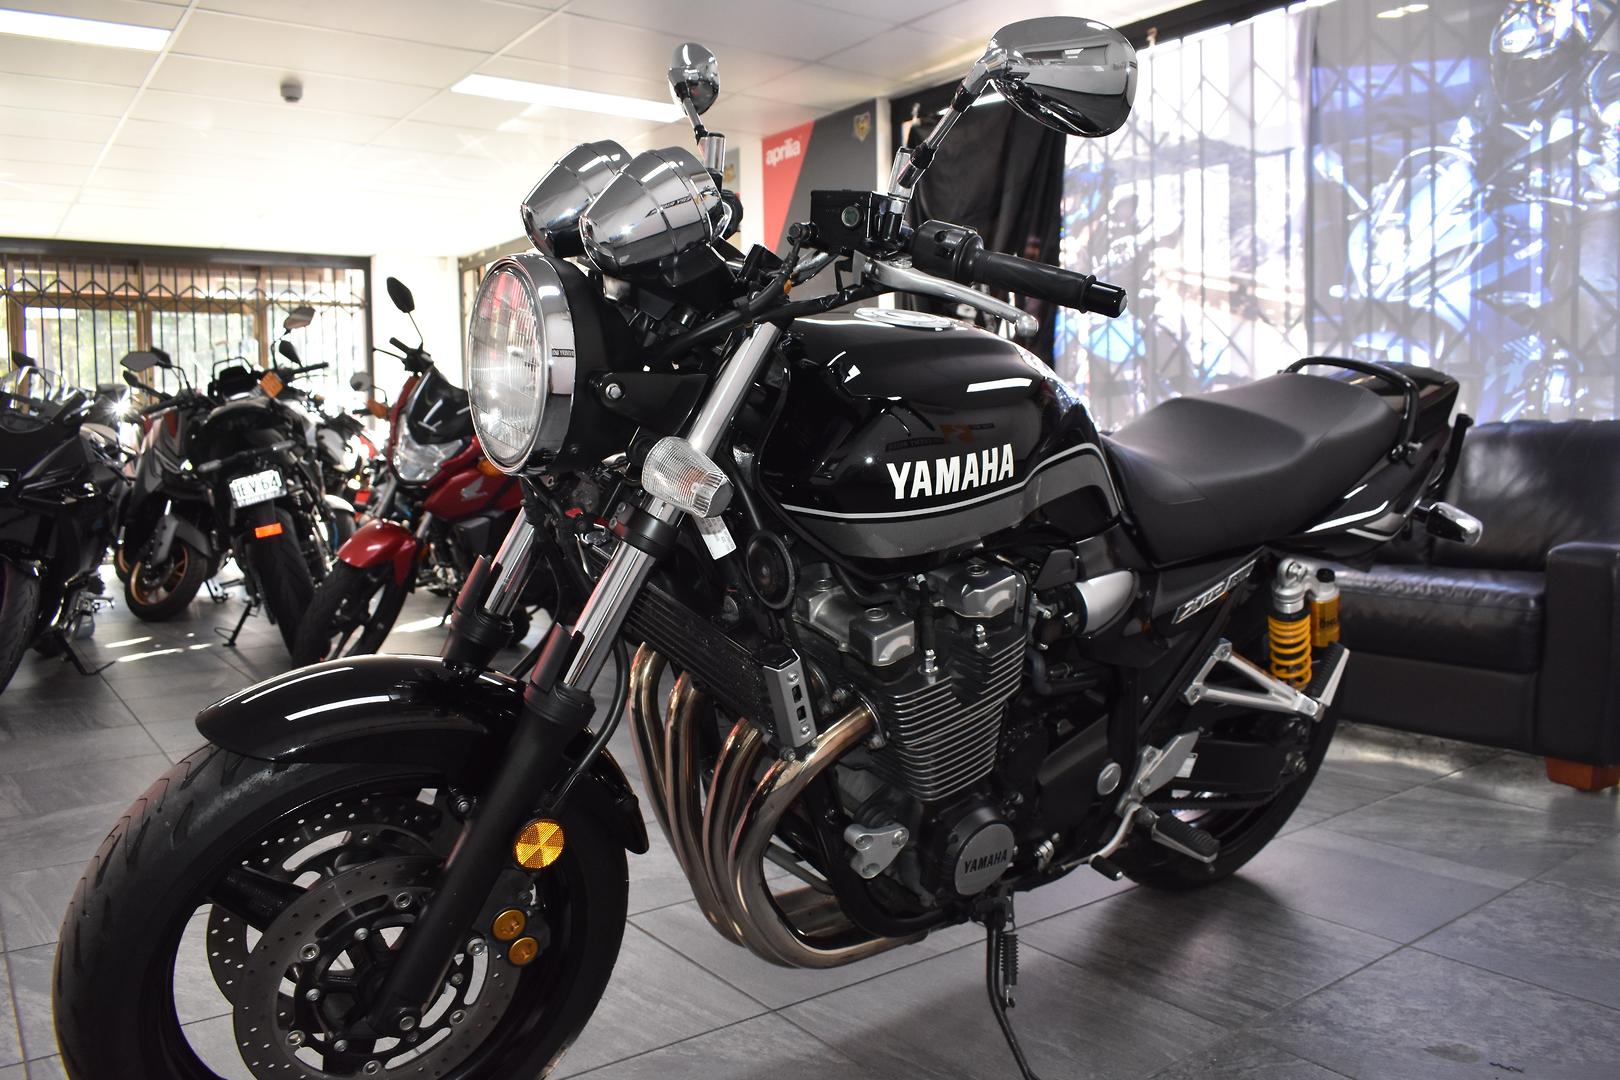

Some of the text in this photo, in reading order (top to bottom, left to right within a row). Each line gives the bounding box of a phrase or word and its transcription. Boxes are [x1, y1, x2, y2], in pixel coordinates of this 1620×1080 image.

[766, 138, 801, 167] aprilia
[886, 443, 1014, 500] YAMAHA
[964, 849, 1008, 875] YAMAHA
